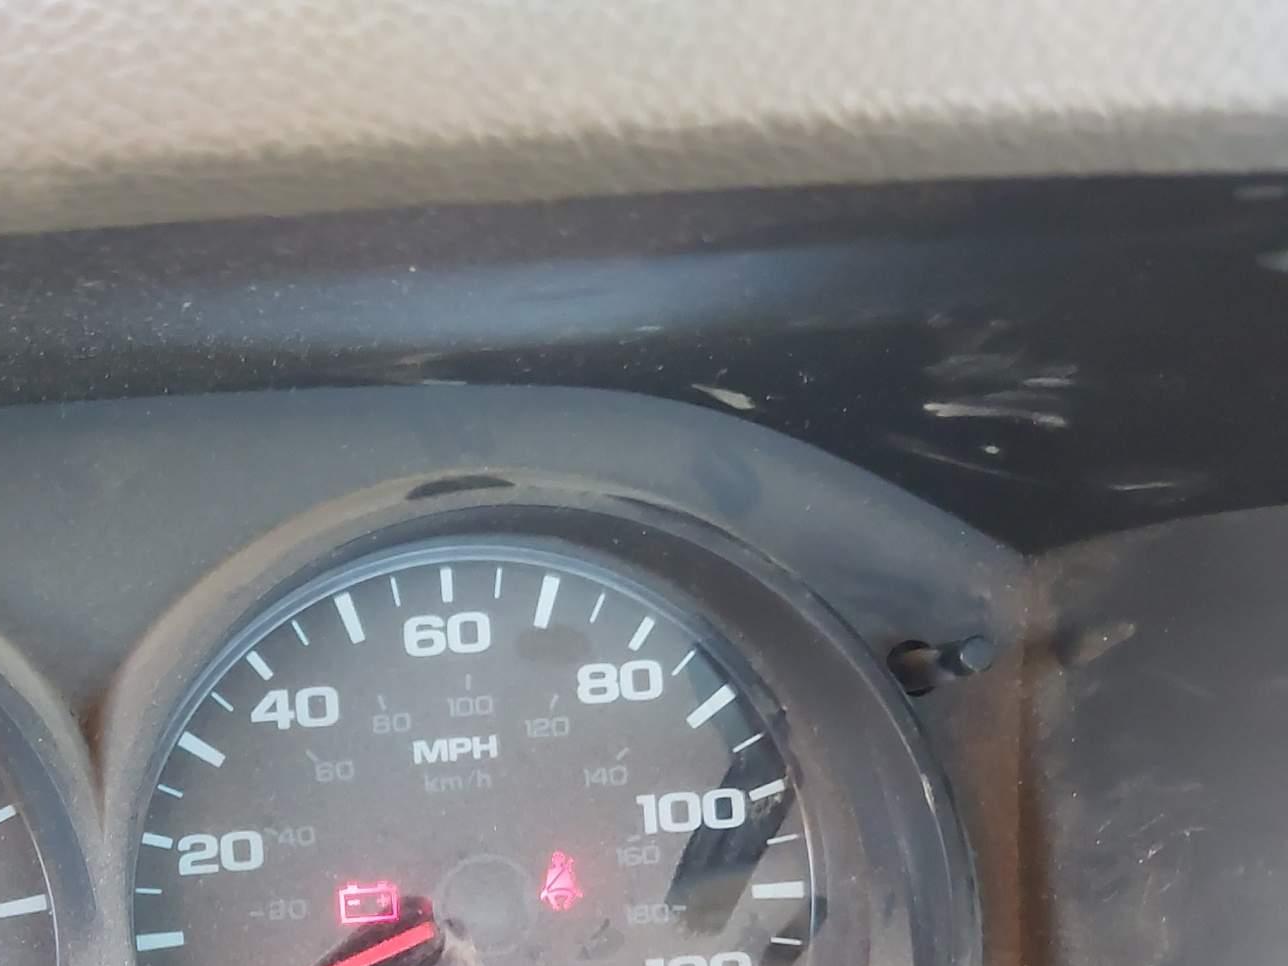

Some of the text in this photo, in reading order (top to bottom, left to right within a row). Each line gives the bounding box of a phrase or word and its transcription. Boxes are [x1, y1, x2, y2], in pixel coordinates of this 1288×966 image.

[403, 611, 491, 657] 60
[576, 659, 663, 704] 80
[250, 686, 339, 730] 40
[448, 695, 494, 717] 100
[372, 713, 411, 734] 80
[525, 716, 570, 738] 120
[413, 734, 498, 764] MPH
[424, 770, 492, 793] km/h
[583, 765, 628, 788] 140
[636, 788, 746, 834] 100
[278, 826, 315, 847] 40
[177, 830, 264, 876] 20
[616, 845, 661, 866] 160
